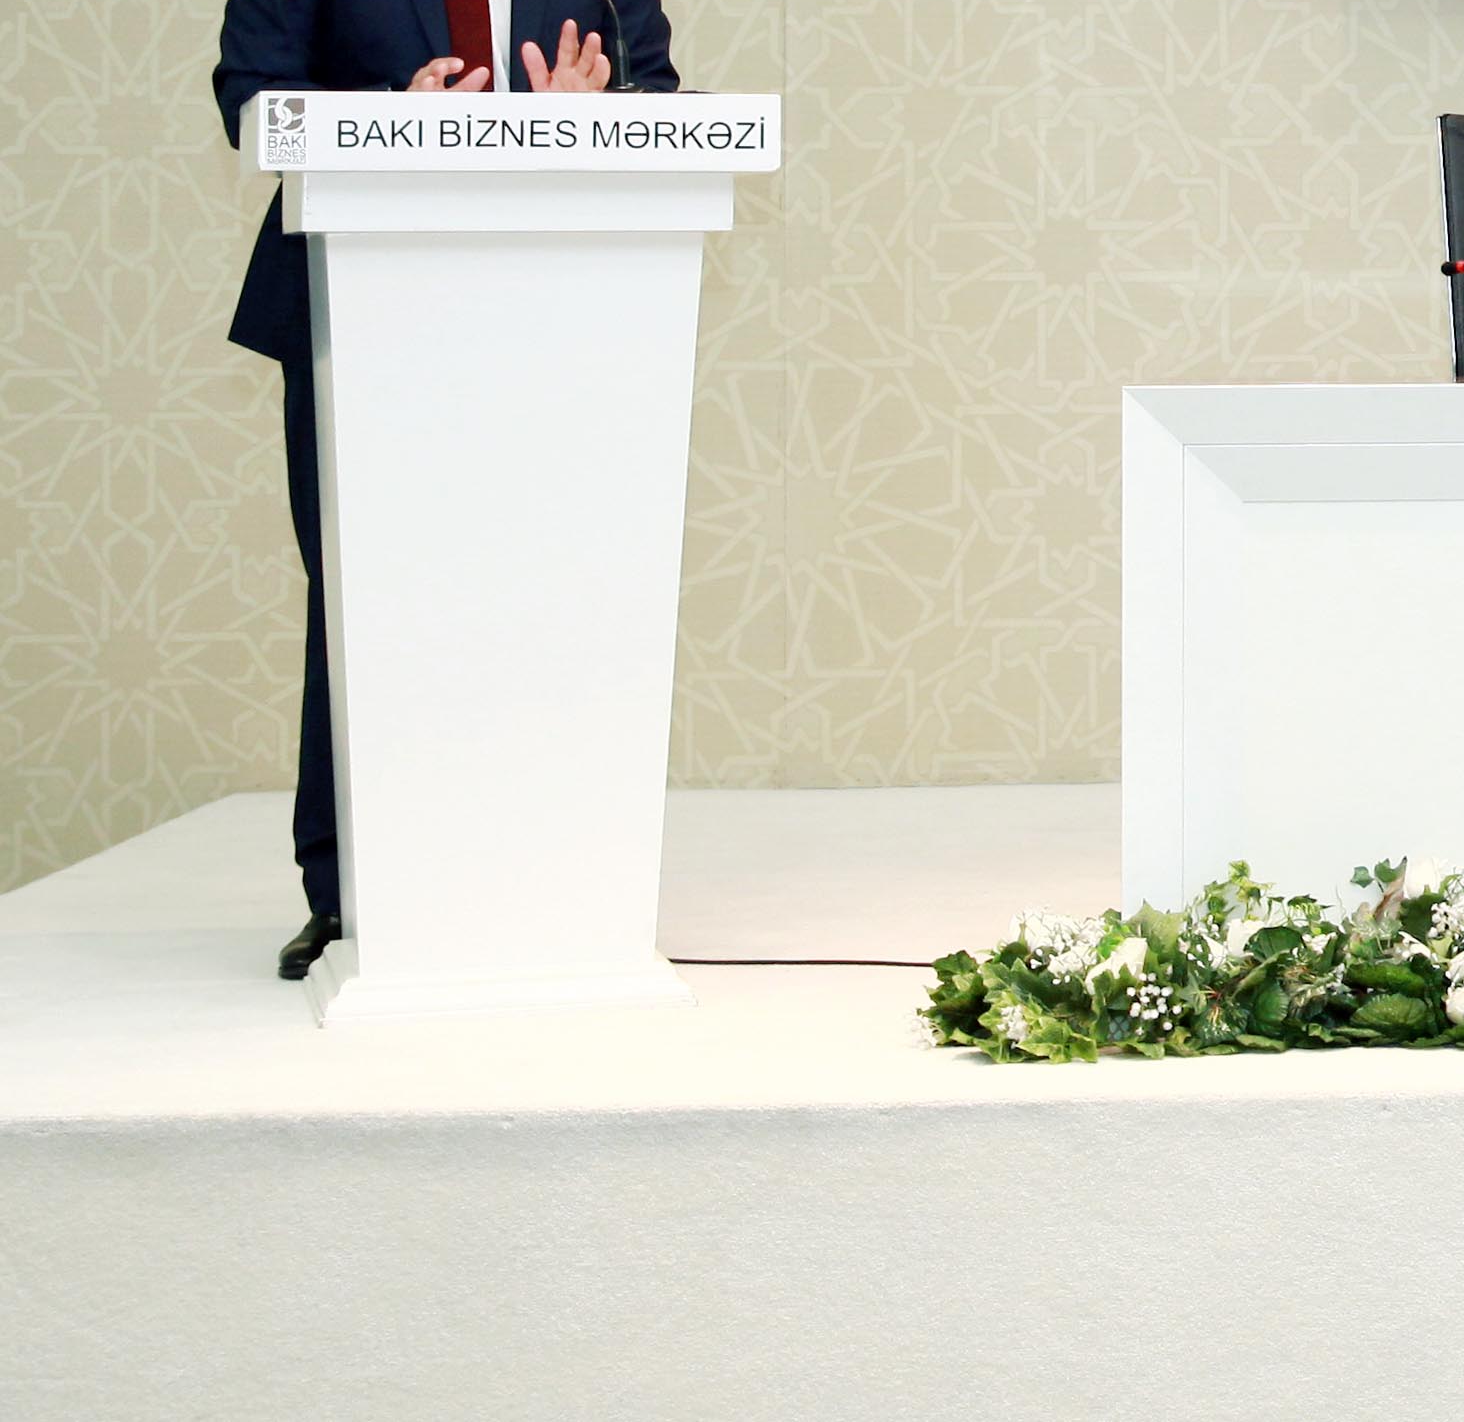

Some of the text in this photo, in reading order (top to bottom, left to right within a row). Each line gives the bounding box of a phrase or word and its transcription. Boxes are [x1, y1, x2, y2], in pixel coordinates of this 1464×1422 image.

[267, 135, 307, 149] BAKI
[336, 113, 766, 151] BAKI BİZNES MƏRKƏZİ
